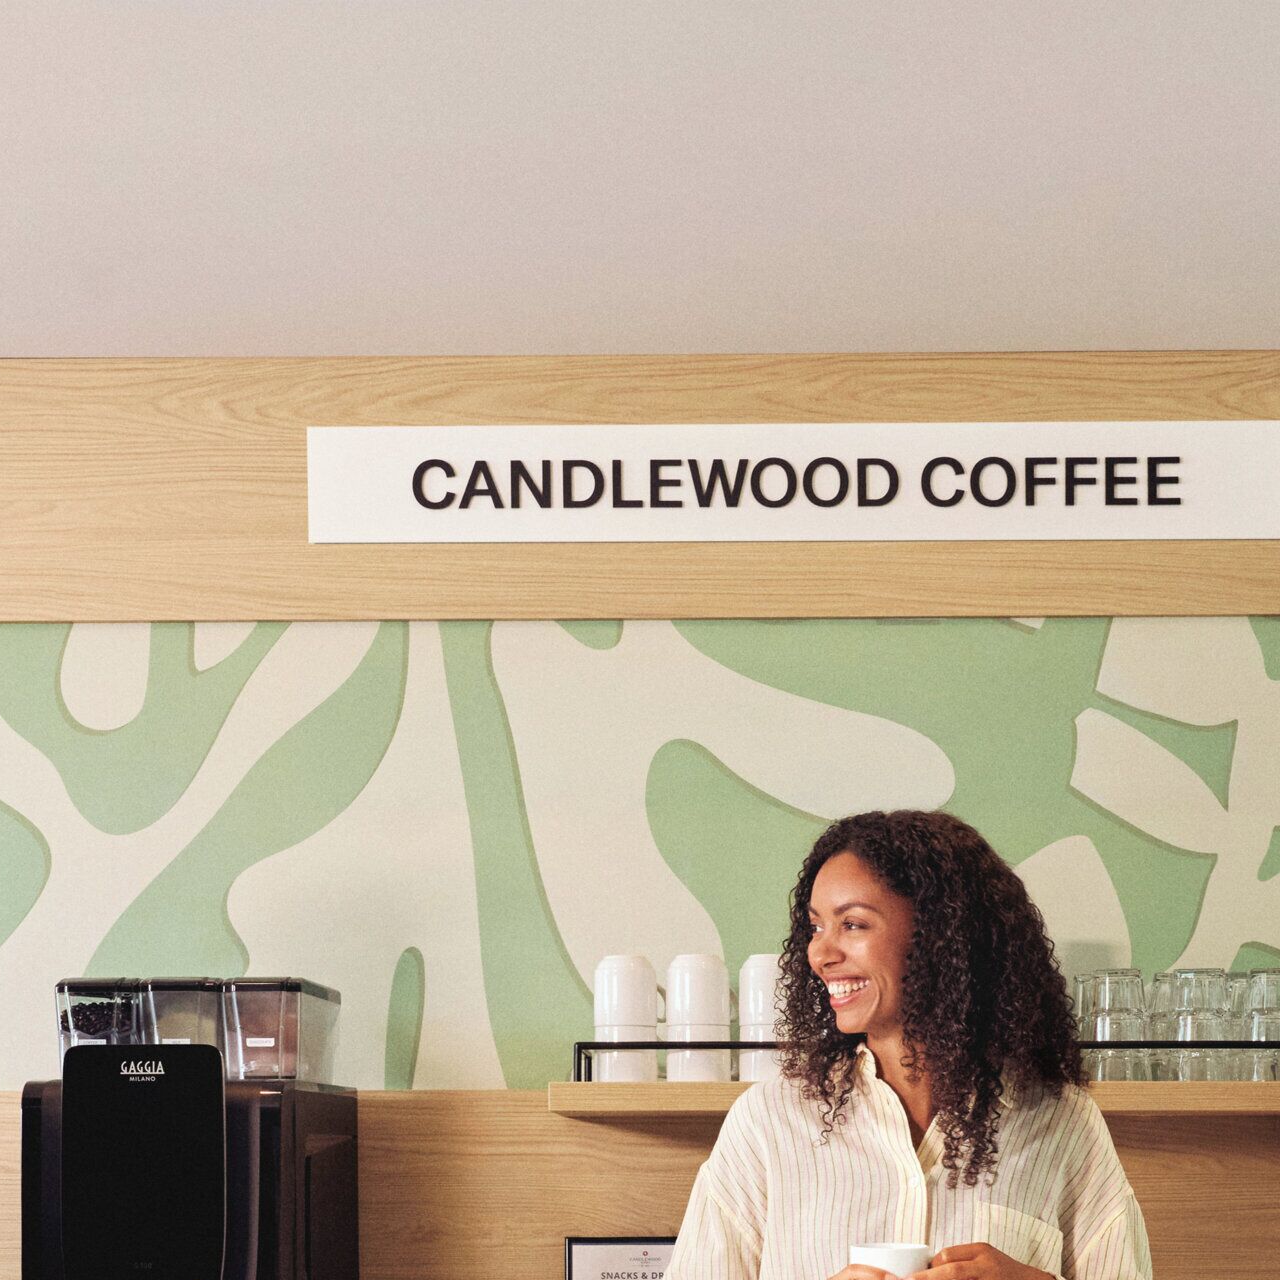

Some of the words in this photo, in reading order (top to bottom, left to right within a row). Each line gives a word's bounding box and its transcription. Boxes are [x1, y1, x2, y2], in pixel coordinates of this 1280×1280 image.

[412, 457, 900, 510] CANDLEWOOD
[920, 456, 1183, 508] COFFEE
[120, 1060, 165, 1075] GAGGIA
[601, 1271, 639, 1280] SNACKS
[641, 1271, 648, 1280] &
